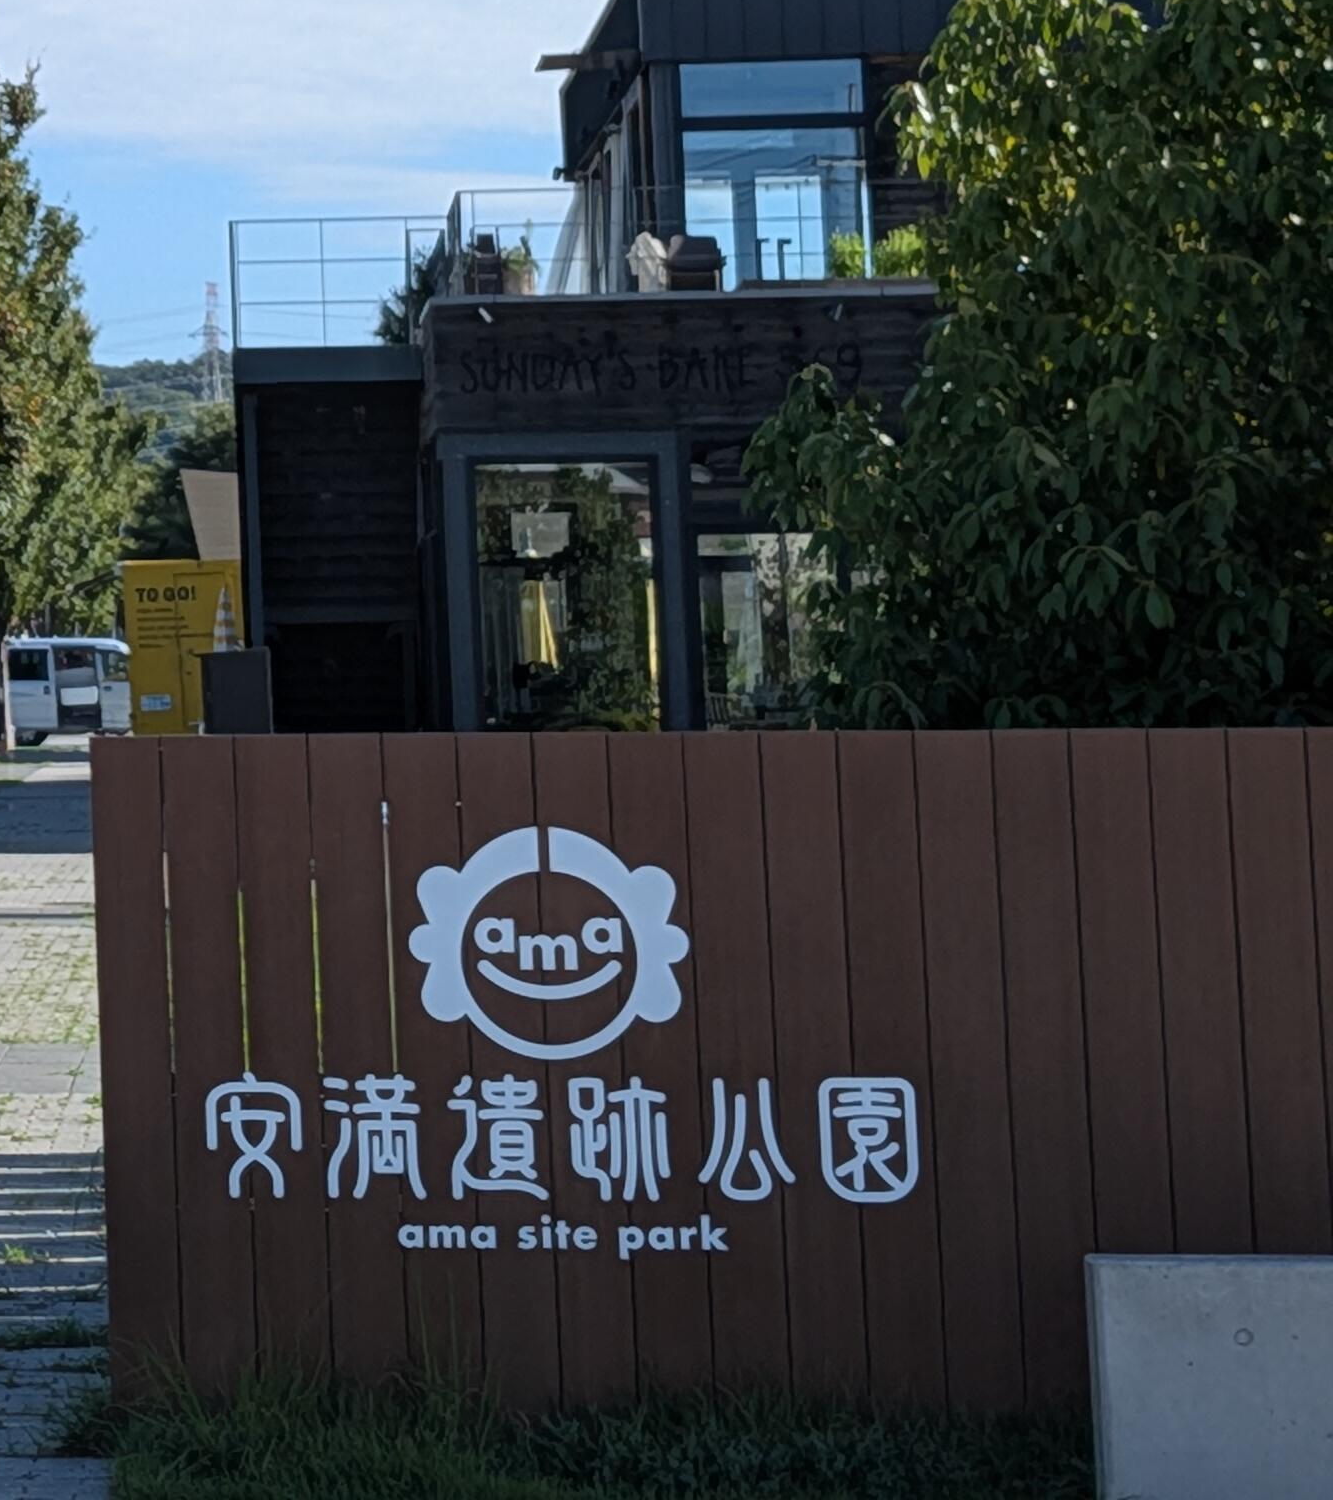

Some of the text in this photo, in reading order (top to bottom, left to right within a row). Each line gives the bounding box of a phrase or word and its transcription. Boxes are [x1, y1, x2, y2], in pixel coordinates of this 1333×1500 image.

[135, 587, 159, 603] TO
[473, 917, 624, 971] ama
[205, 1071, 920, 1203] 安満遺跡公園
[397, 1214, 729, 1261] ama site park
